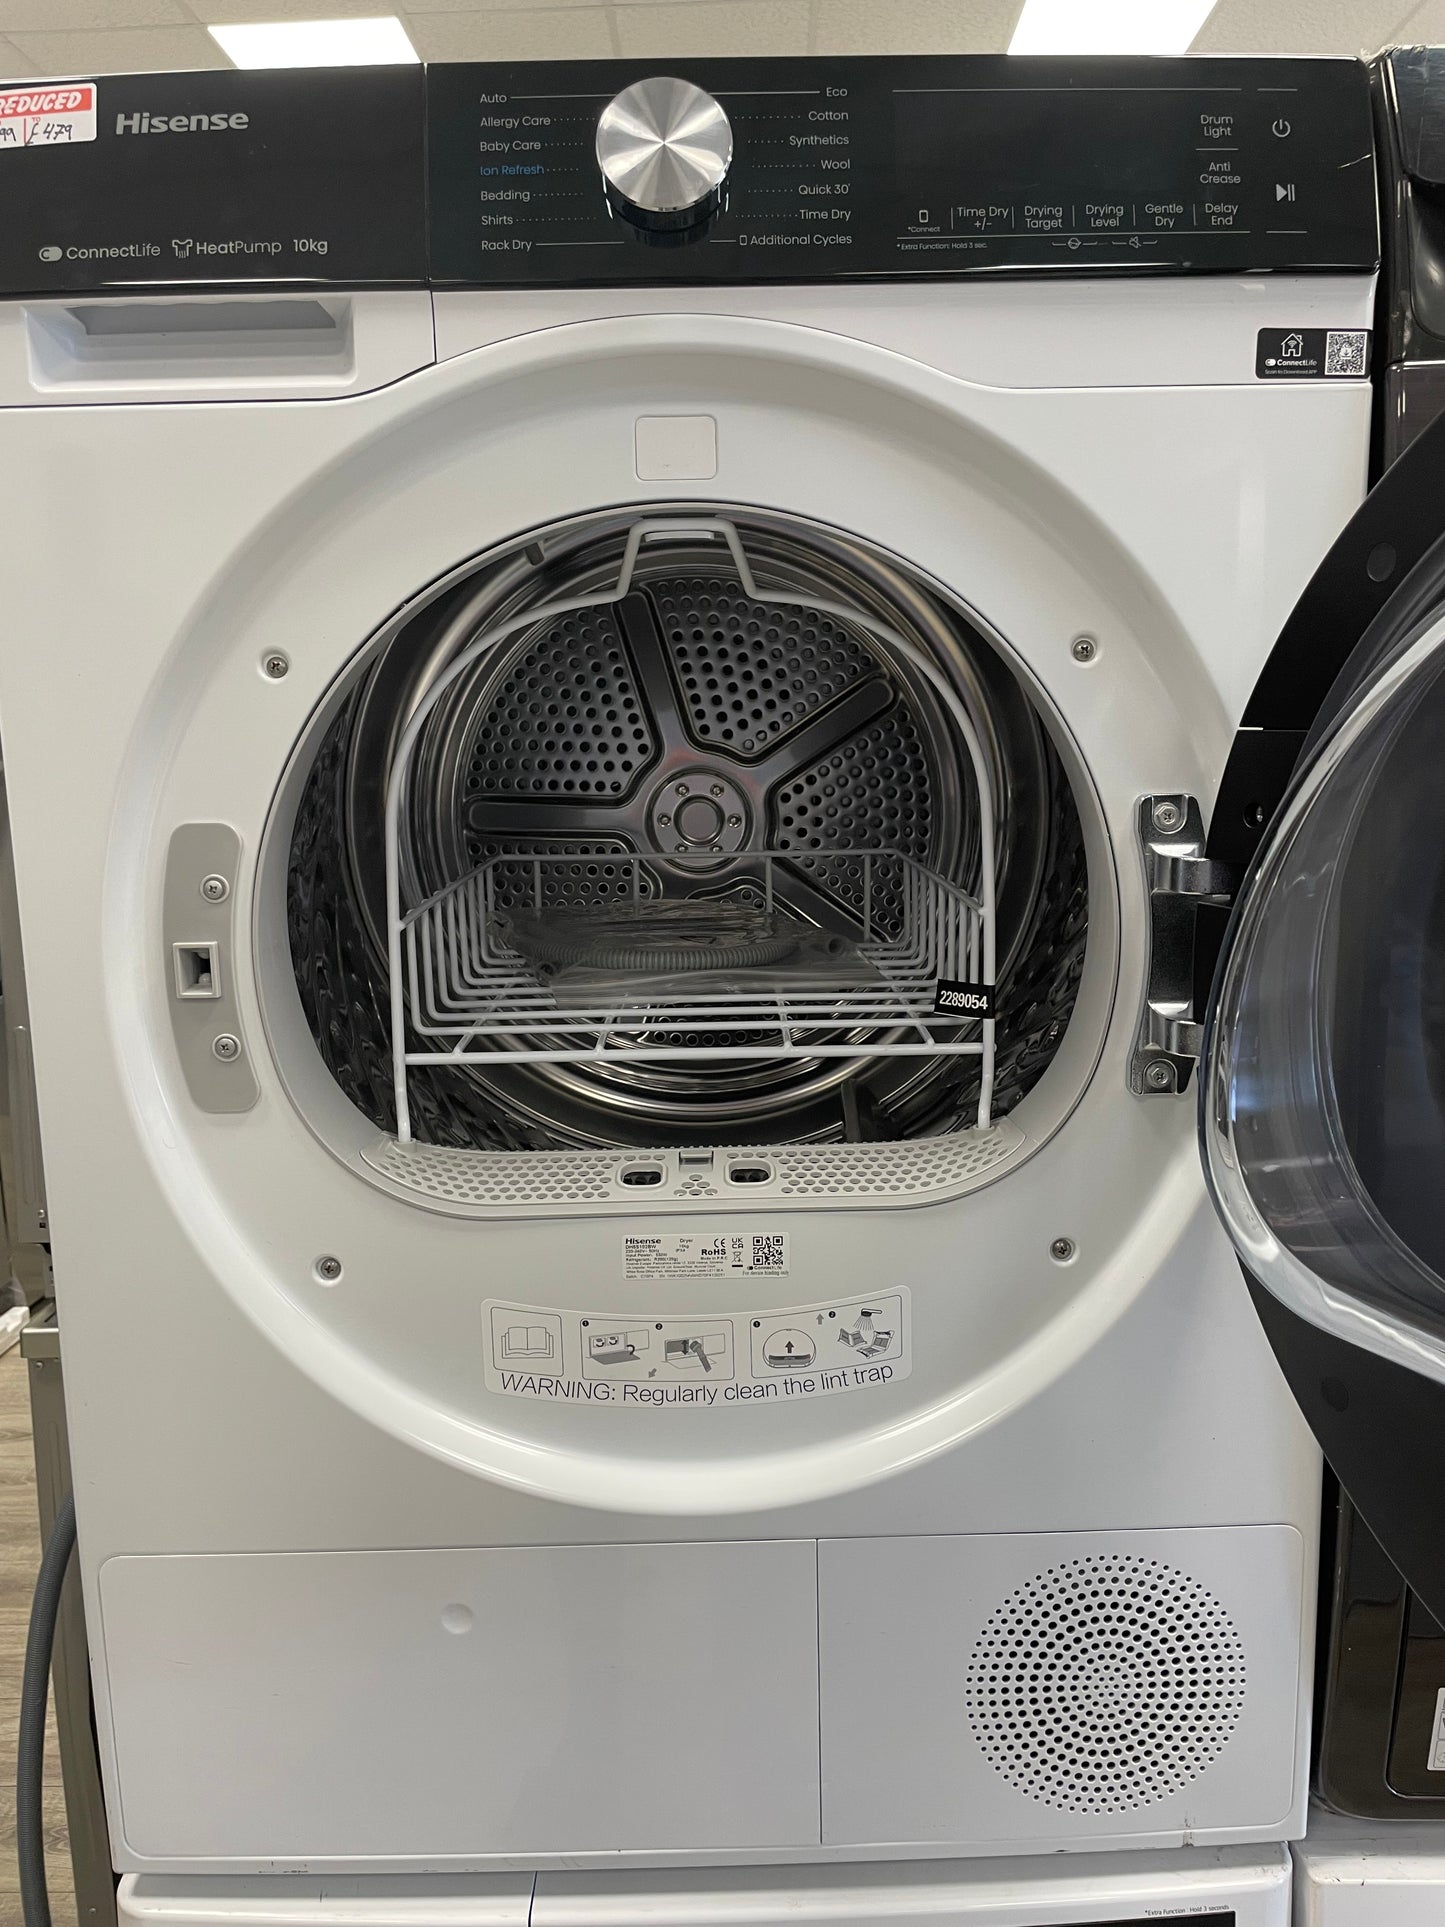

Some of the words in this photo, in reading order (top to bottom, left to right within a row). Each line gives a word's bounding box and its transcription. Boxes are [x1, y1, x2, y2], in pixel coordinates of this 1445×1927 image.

[480, 93, 507, 103] Auto
[826, 87, 848, 97] Eco
[808, 110, 849, 121] Cotton
[1201, 114, 1233, 125] Drum
[115, 112, 249, 135] Hisense
[480, 116, 521, 129] Allergy
[523, 116, 551, 126] Care
[1204, 126, 1231, 138] Light
[480, 140, 512, 153] Baby
[514, 140, 541, 151] Care
[789, 135, 849, 148] Synthetics
[480, 165, 500, 176] Ion
[501, 164, 544, 175] Refresh
[821, 159, 850, 170] Wool
[1208, 161, 1231, 172] Anti
[1200, 173, 1241, 184] Crease
[481, 189, 530, 203] Bedding
[798, 185, 832, 195] Quick
[799, 209, 827, 220] Time
[829, 209, 851, 222] Dry
[957, 207, 986, 217] Time
[988, 206, 1009, 220] Dry
[1024, 205, 1063, 219] Drying
[1086, 204, 1124, 219] Drying
[1145, 204, 1184, 215] Gentle
[1205, 203, 1238, 217] Delay
[481, 214, 513, 225] Shirts
[1025, 218, 1062, 231] Target
[1091, 217, 1119, 228] Level
[1155, 216, 1175, 229] Dry
[1211, 215, 1232, 226] End
[481, 240, 509, 251] Rack
[511, 239, 533, 252] Dry
[750, 234, 811, 245] Additional
[813, 233, 852, 247] Cycles
[66, 243, 161, 261] ConnectLife
[196, 240, 282, 256] HeatPump
[293, 239, 328, 255] 10kg
[939, 990, 989, 1010] 2289054
[501, 1372, 616, 1401] WARNING:
[623, 1384, 718, 1406] Regularly
[724, 1382, 778, 1401] clean
[783, 1377, 815, 1395] the
[820, 1370, 849, 1390] lint
[853, 1365, 893, 1384] trap
